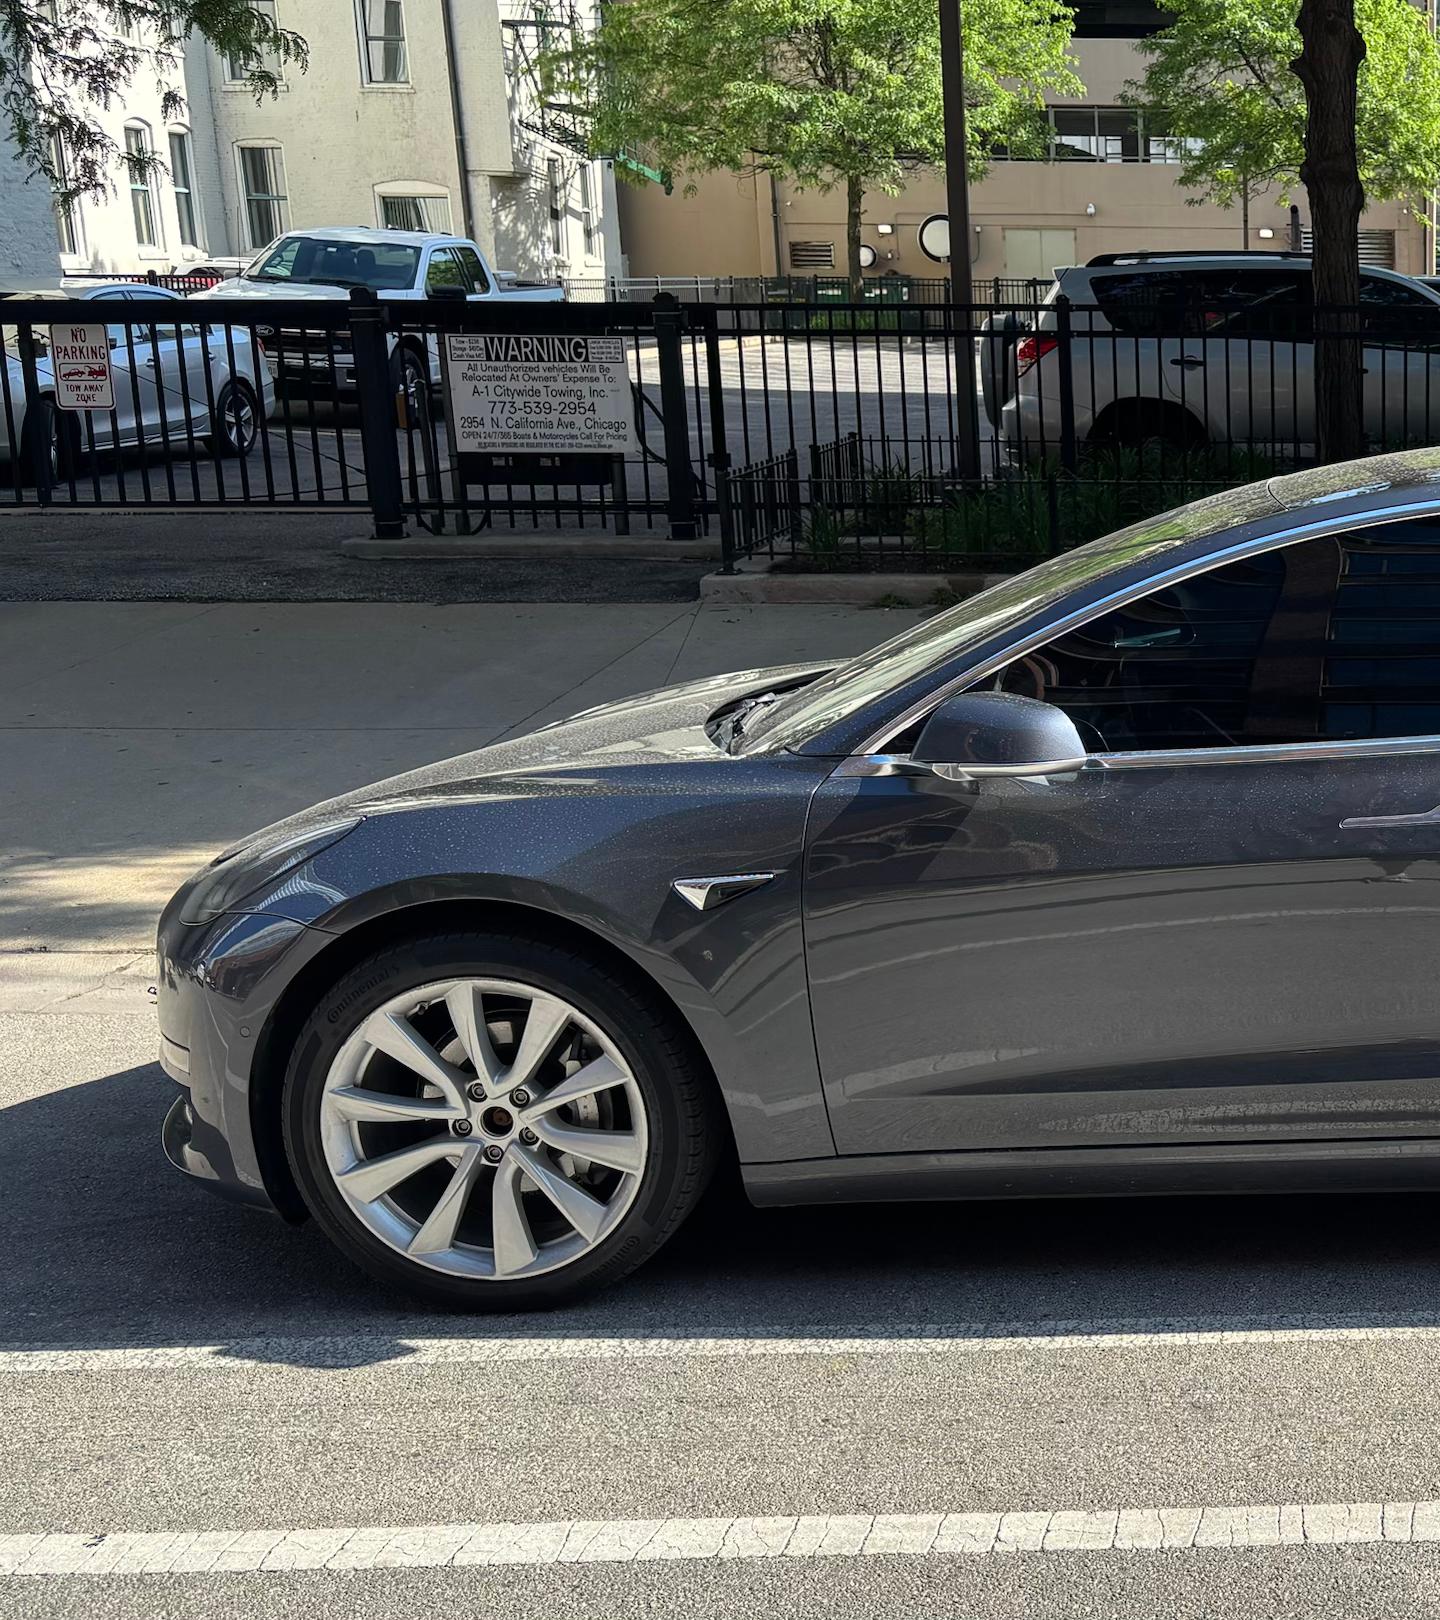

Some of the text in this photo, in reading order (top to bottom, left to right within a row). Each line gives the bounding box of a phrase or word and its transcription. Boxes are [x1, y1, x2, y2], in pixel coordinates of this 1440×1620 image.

[71, 328, 87, 342] NO
[55, 345, 106, 360] PARKING
[486, 337, 587, 362] WARNING
[467, 363, 610, 373] All Unauthorized vehicles Will Be
[462, 372, 616, 384] Relocated At Owners' Expense To:
[66, 384, 104, 392] TOW AWAY
[472, 384, 609, 400] A-1 Citywide Towing, Inc.
[76, 393, 96, 402] ZONE
[487, 400, 597, 415] 773-539-2954
[460, 416, 627, 432] 2954 N. California Ave., Chicago
[461, 431, 627, 442] OPEN 24/7/365 Boats & Motorcycles Call For Pricing
[327, 968, 392, 1024] Continental
